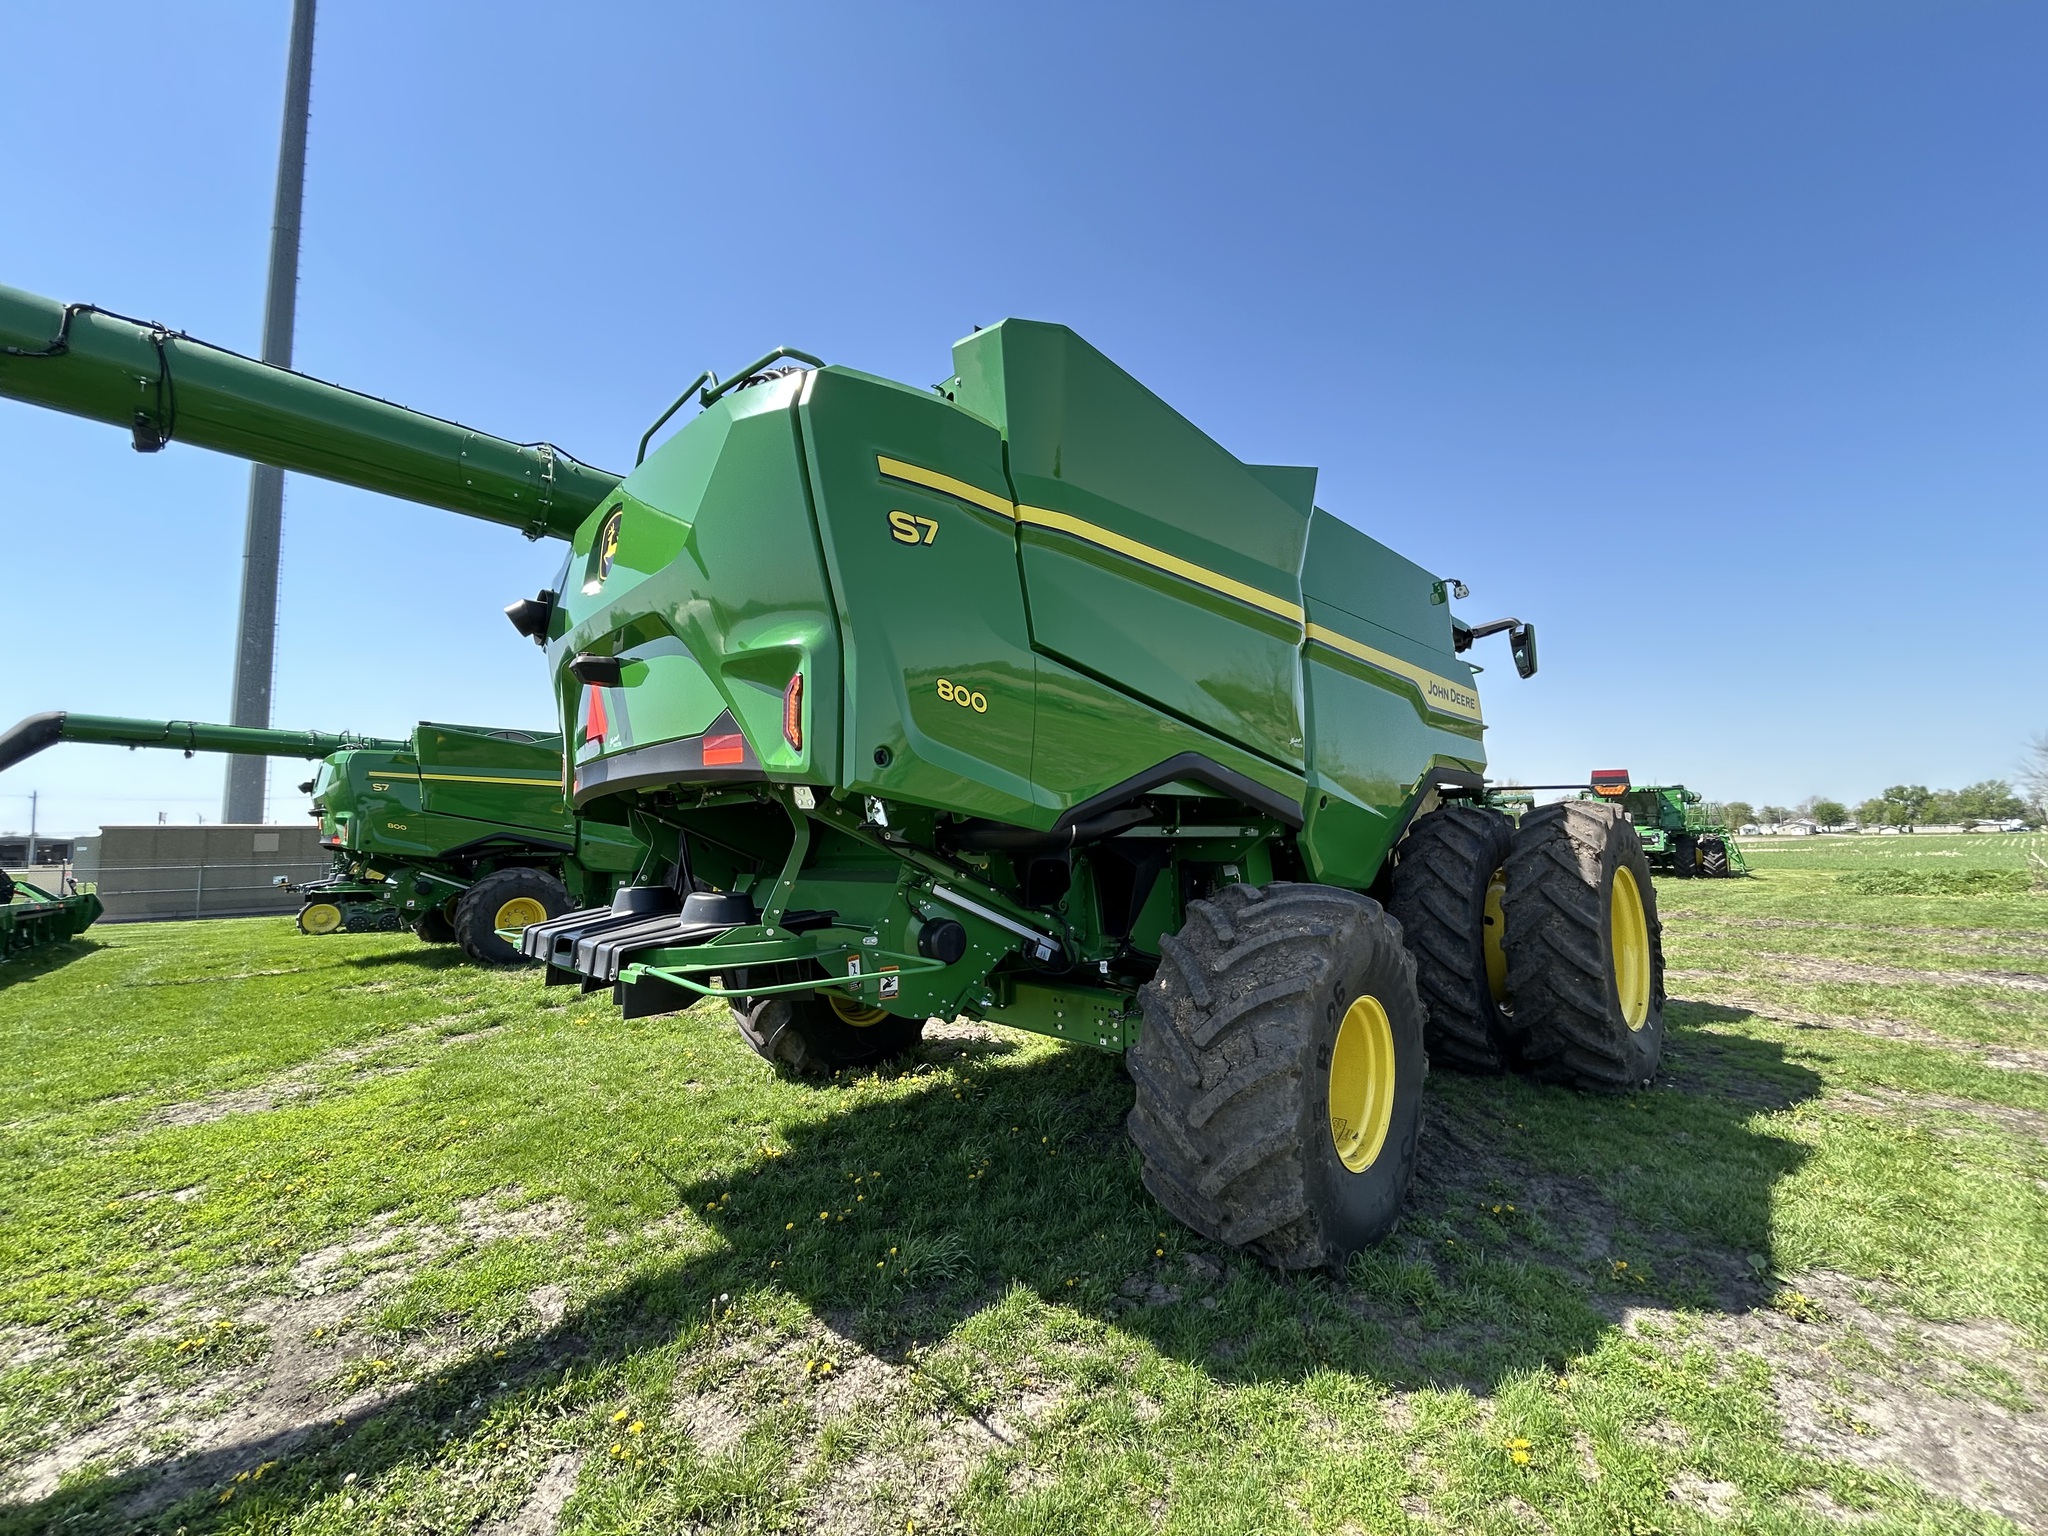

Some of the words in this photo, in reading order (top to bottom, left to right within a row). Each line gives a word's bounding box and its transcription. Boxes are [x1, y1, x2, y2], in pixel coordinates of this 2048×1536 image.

[888, 510, 939, 546] S7
[936, 678, 988, 714] 800
[1428, 680, 1449, 700] JOHN
[1450, 688, 1476, 709] DEERE
[372, 782, 390, 792] S7
[387, 822, 407, 831] 800
